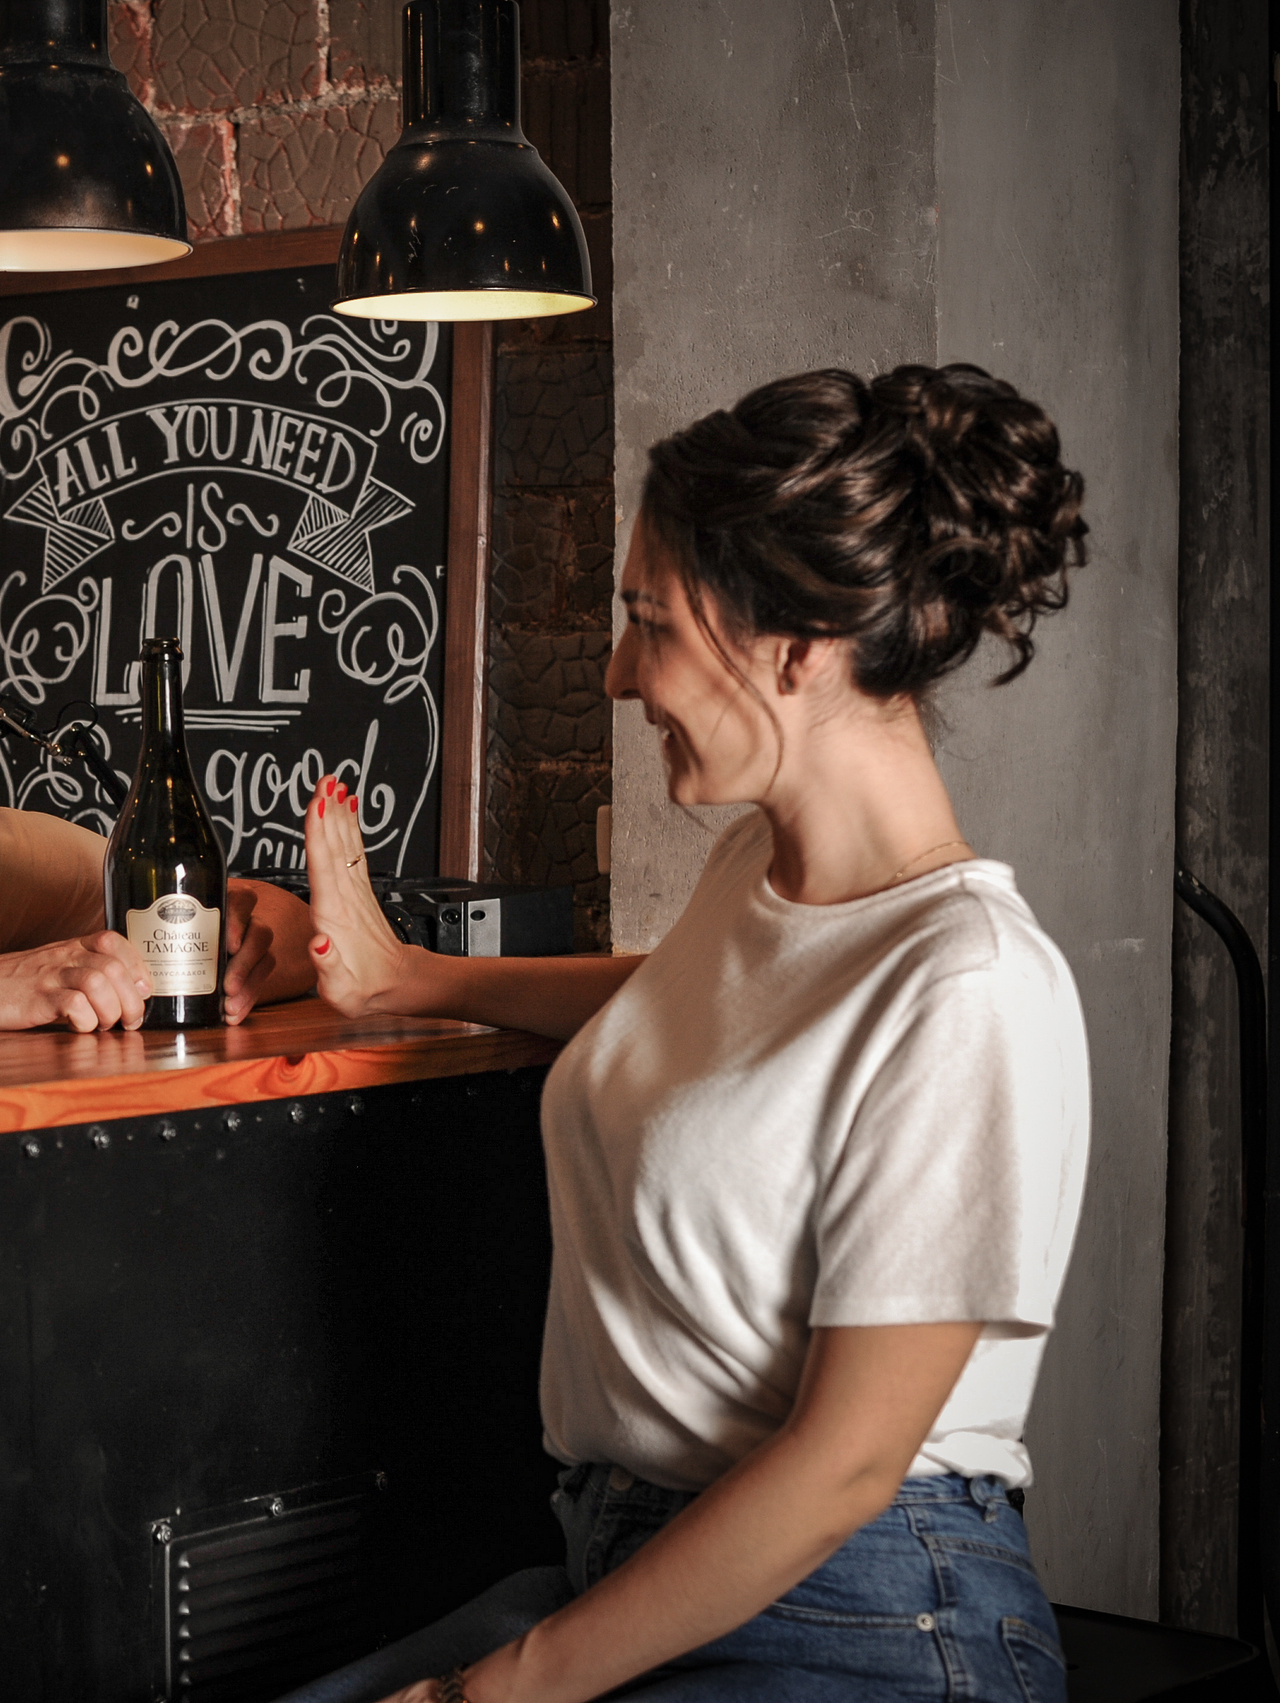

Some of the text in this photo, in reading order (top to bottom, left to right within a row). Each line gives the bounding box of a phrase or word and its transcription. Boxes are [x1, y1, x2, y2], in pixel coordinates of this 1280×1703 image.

[54, 405, 356, 506] ALL YOU NEED
[186, 481, 227, 552] IS
[93, 553, 313, 706] LOVE
[205, 718, 395, 868] good
[142, 940, 210, 953] TAMAGNE
